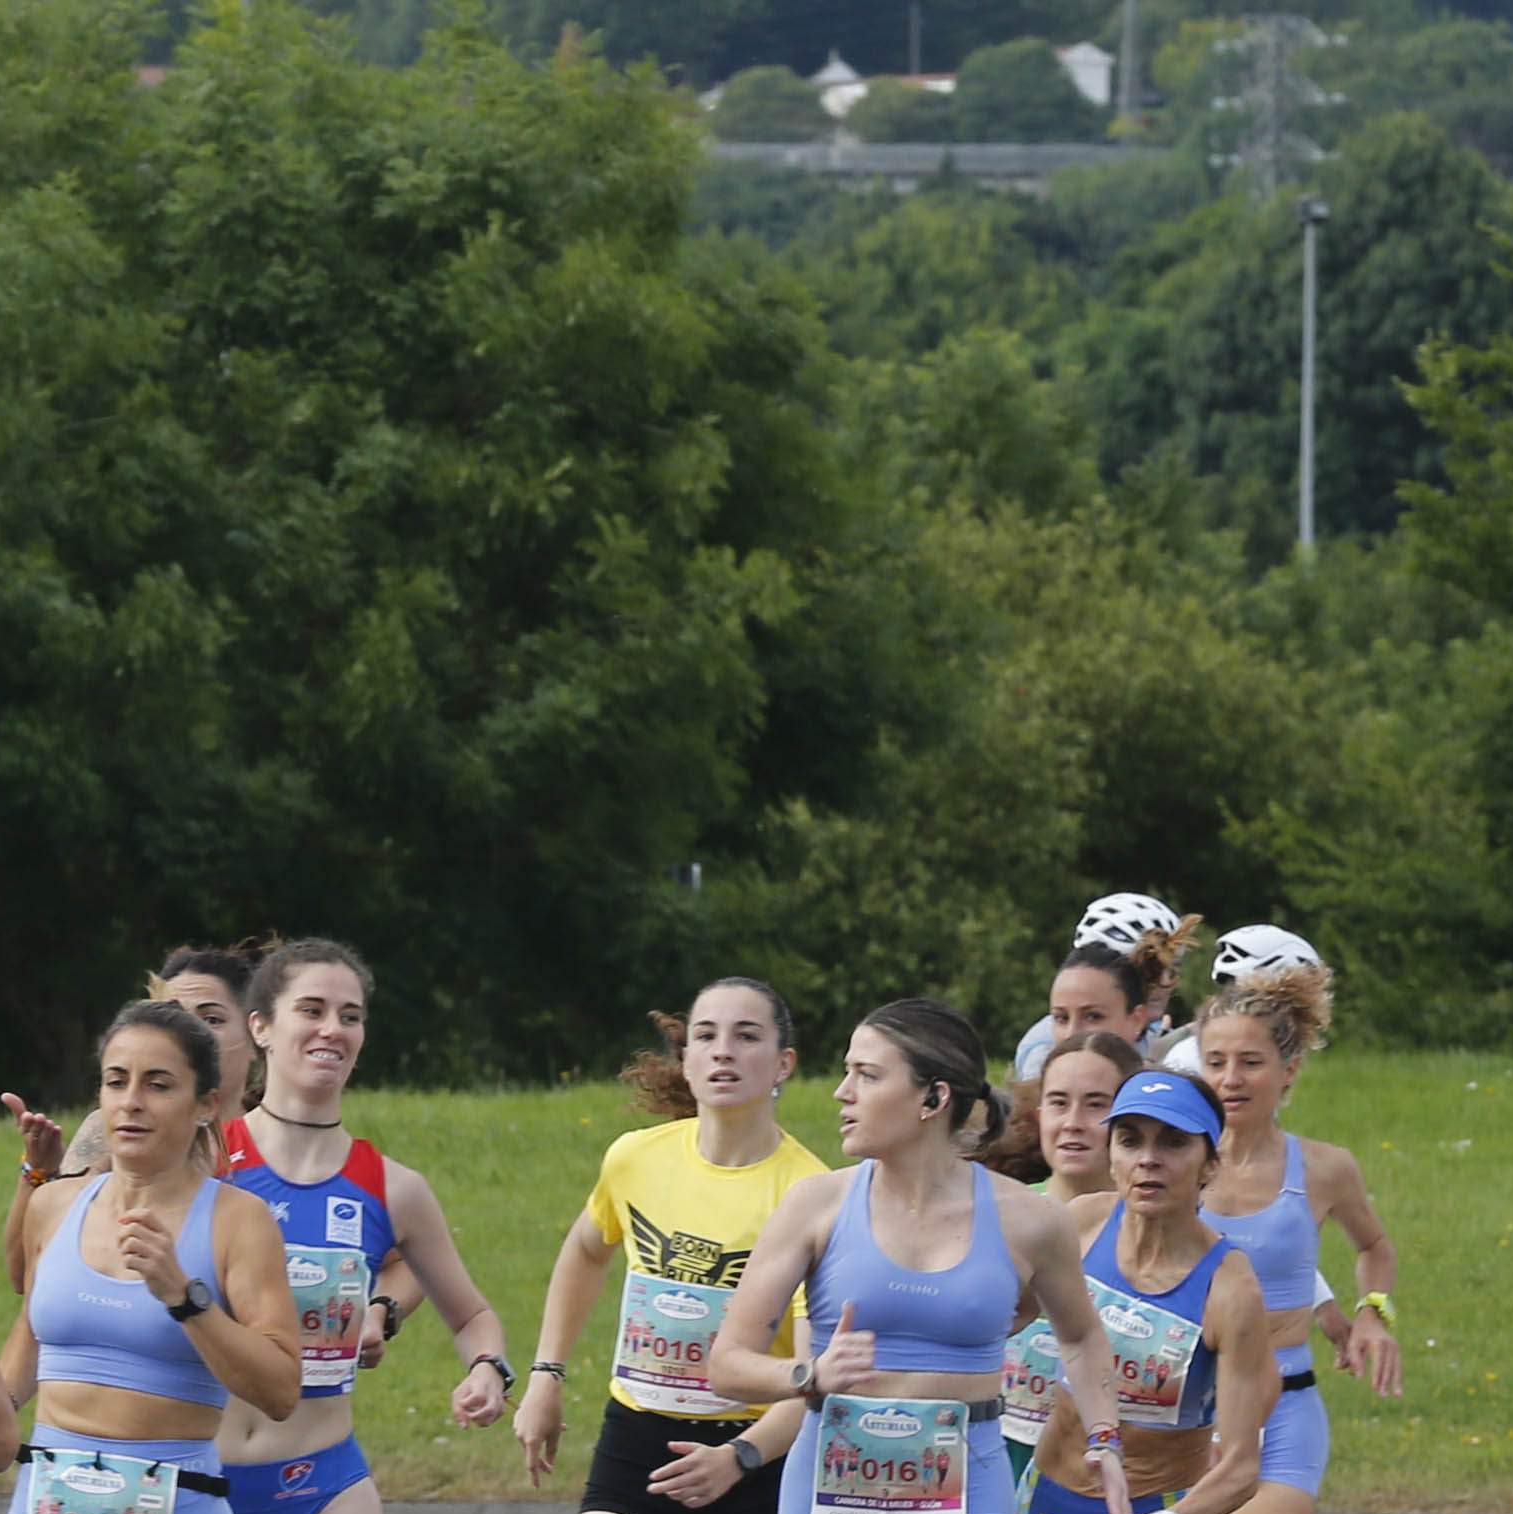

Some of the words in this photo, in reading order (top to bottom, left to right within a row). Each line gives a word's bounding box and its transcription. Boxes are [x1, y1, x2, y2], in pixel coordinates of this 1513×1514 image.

[671, 1234, 720, 1260] BORN
[887, 1280, 940, 1297] OYSHO
[1100, 1309, 1152, 1337] ASTURIANA
[653, 1337, 703, 1362] 016
[862, 1417, 919, 1432] ASTURIANA
[860, 1458, 918, 1482] 016
